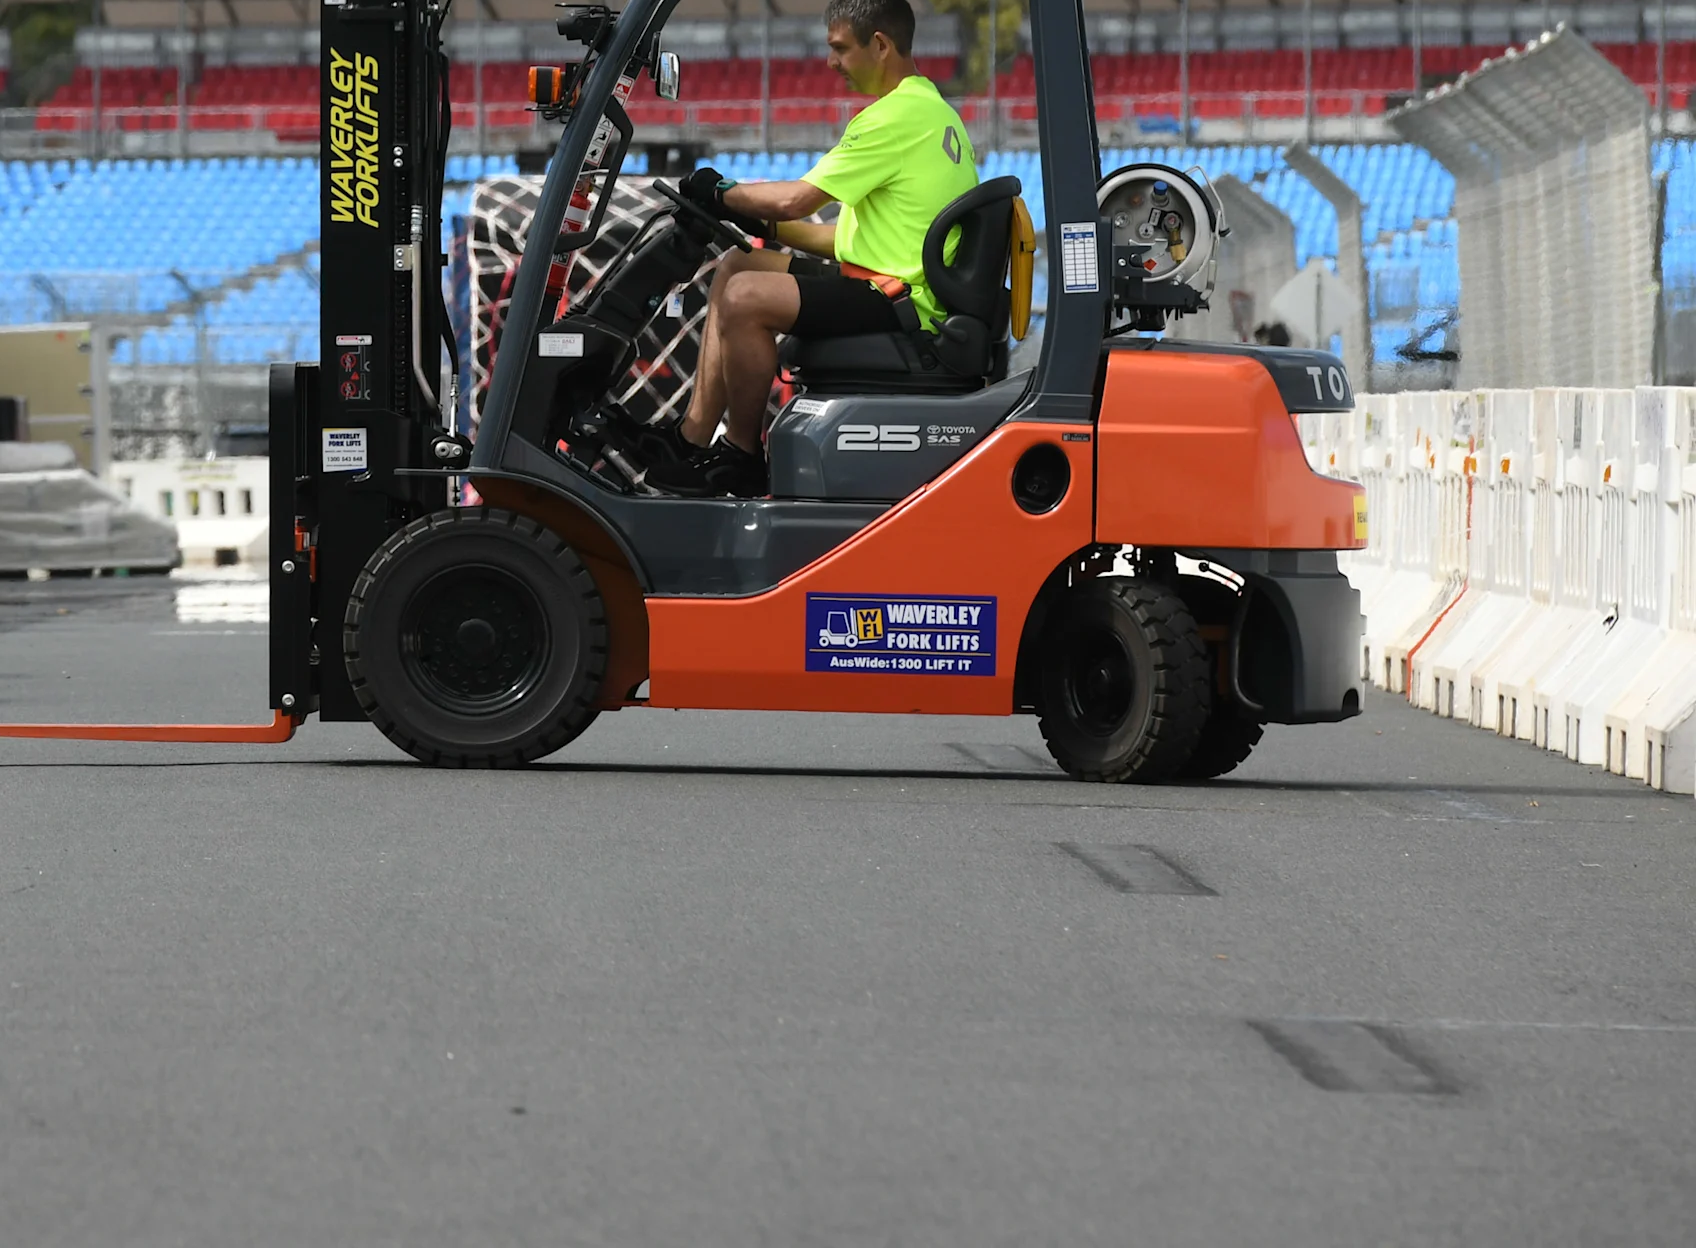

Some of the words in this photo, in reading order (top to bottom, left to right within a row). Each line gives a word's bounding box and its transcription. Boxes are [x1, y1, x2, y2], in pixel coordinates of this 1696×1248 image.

[330, 47, 354, 223] WAVERLEY
[355, 52, 379, 228] FORKLIFTS
[837, 424, 921, 451] 25
[927, 435, 961, 443] SAS
[941, 426, 976, 434] TOYOTA
[887, 604, 981, 626] WAVERLEY
[886, 633, 932, 649] FORK
[936, 635, 980, 651] LIFTS
[925, 658, 955, 671] LIFT
[958, 659, 972, 671] IT
